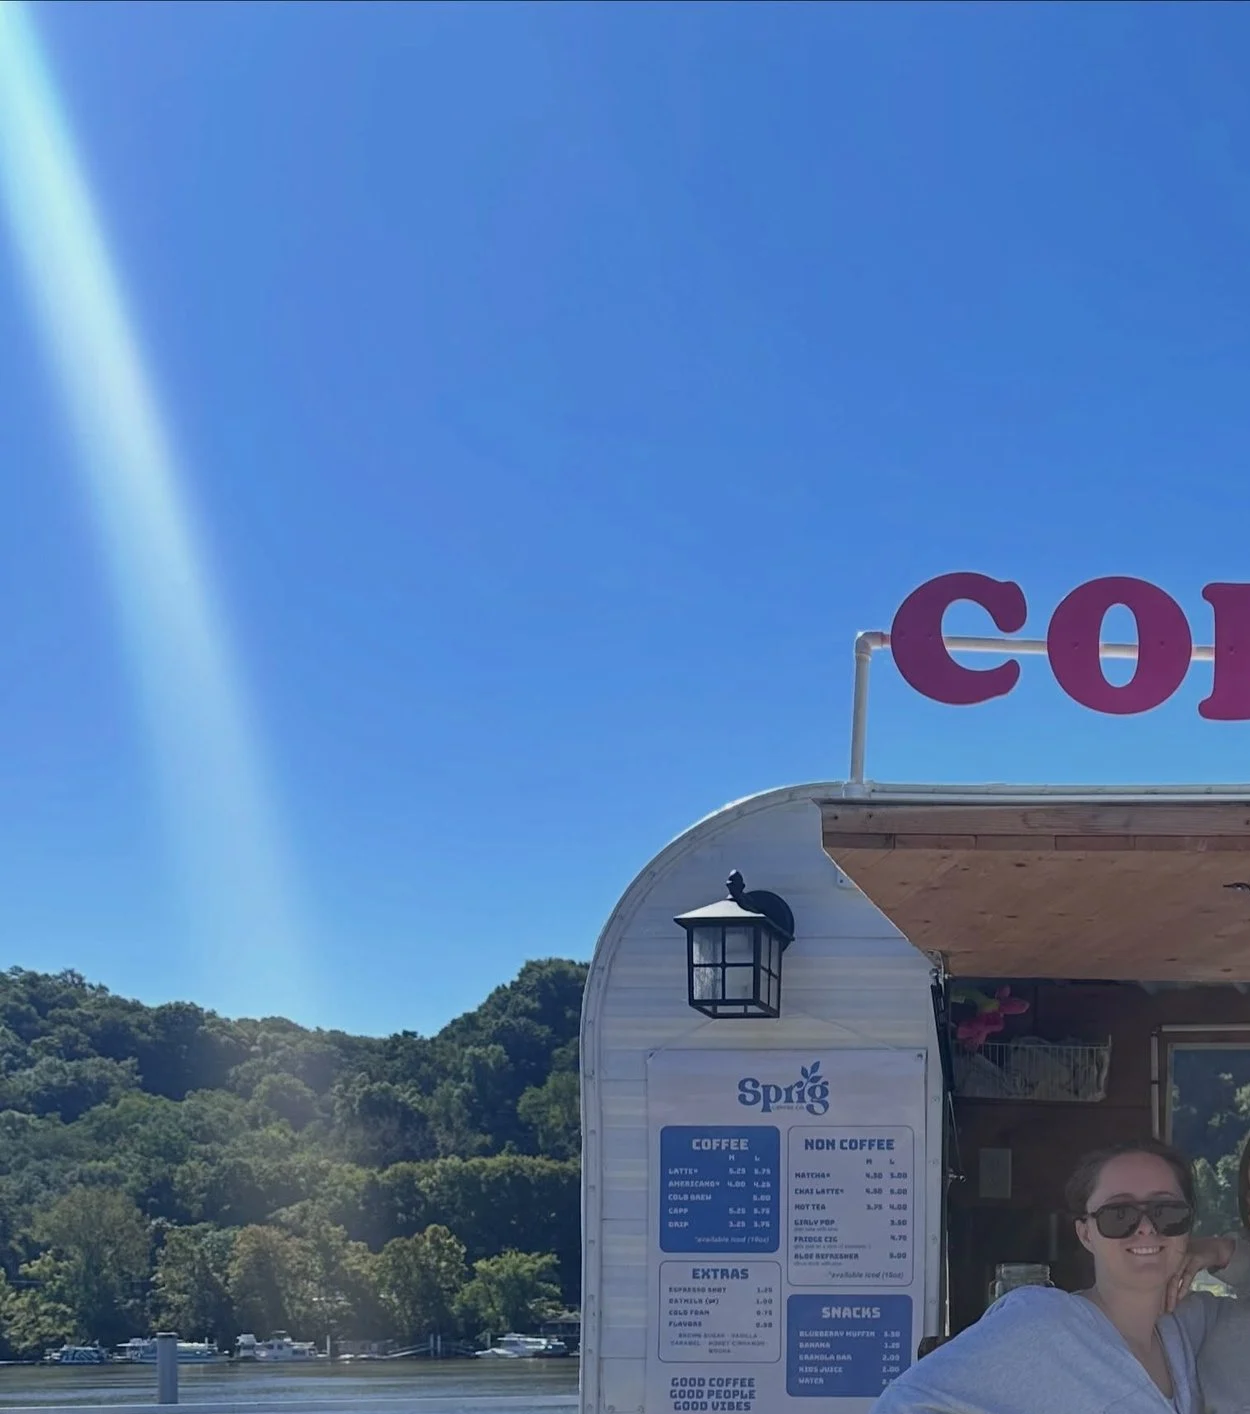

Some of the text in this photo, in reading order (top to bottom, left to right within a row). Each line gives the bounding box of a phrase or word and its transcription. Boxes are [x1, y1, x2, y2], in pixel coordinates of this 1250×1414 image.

[738, 1061, 829, 1115] Sprig
[692, 1138, 749, 1150] COFFEE
[804, 1139, 895, 1150] NON COFFEE
[692, 1268, 749, 1280] EXTRAS
[864, 1271, 881, 1279] iced
[821, 1307, 881, 1319] SNACKS
[845, 1330, 876, 1338] MUFFIN
[671, 1377, 755, 1388] GOOD COFFEE
[798, 1377, 824, 1385] WATER
[670, 1389, 755, 1400] GOOD PEOPLE
[673, 1401, 751, 1411] GOOD VIBES
